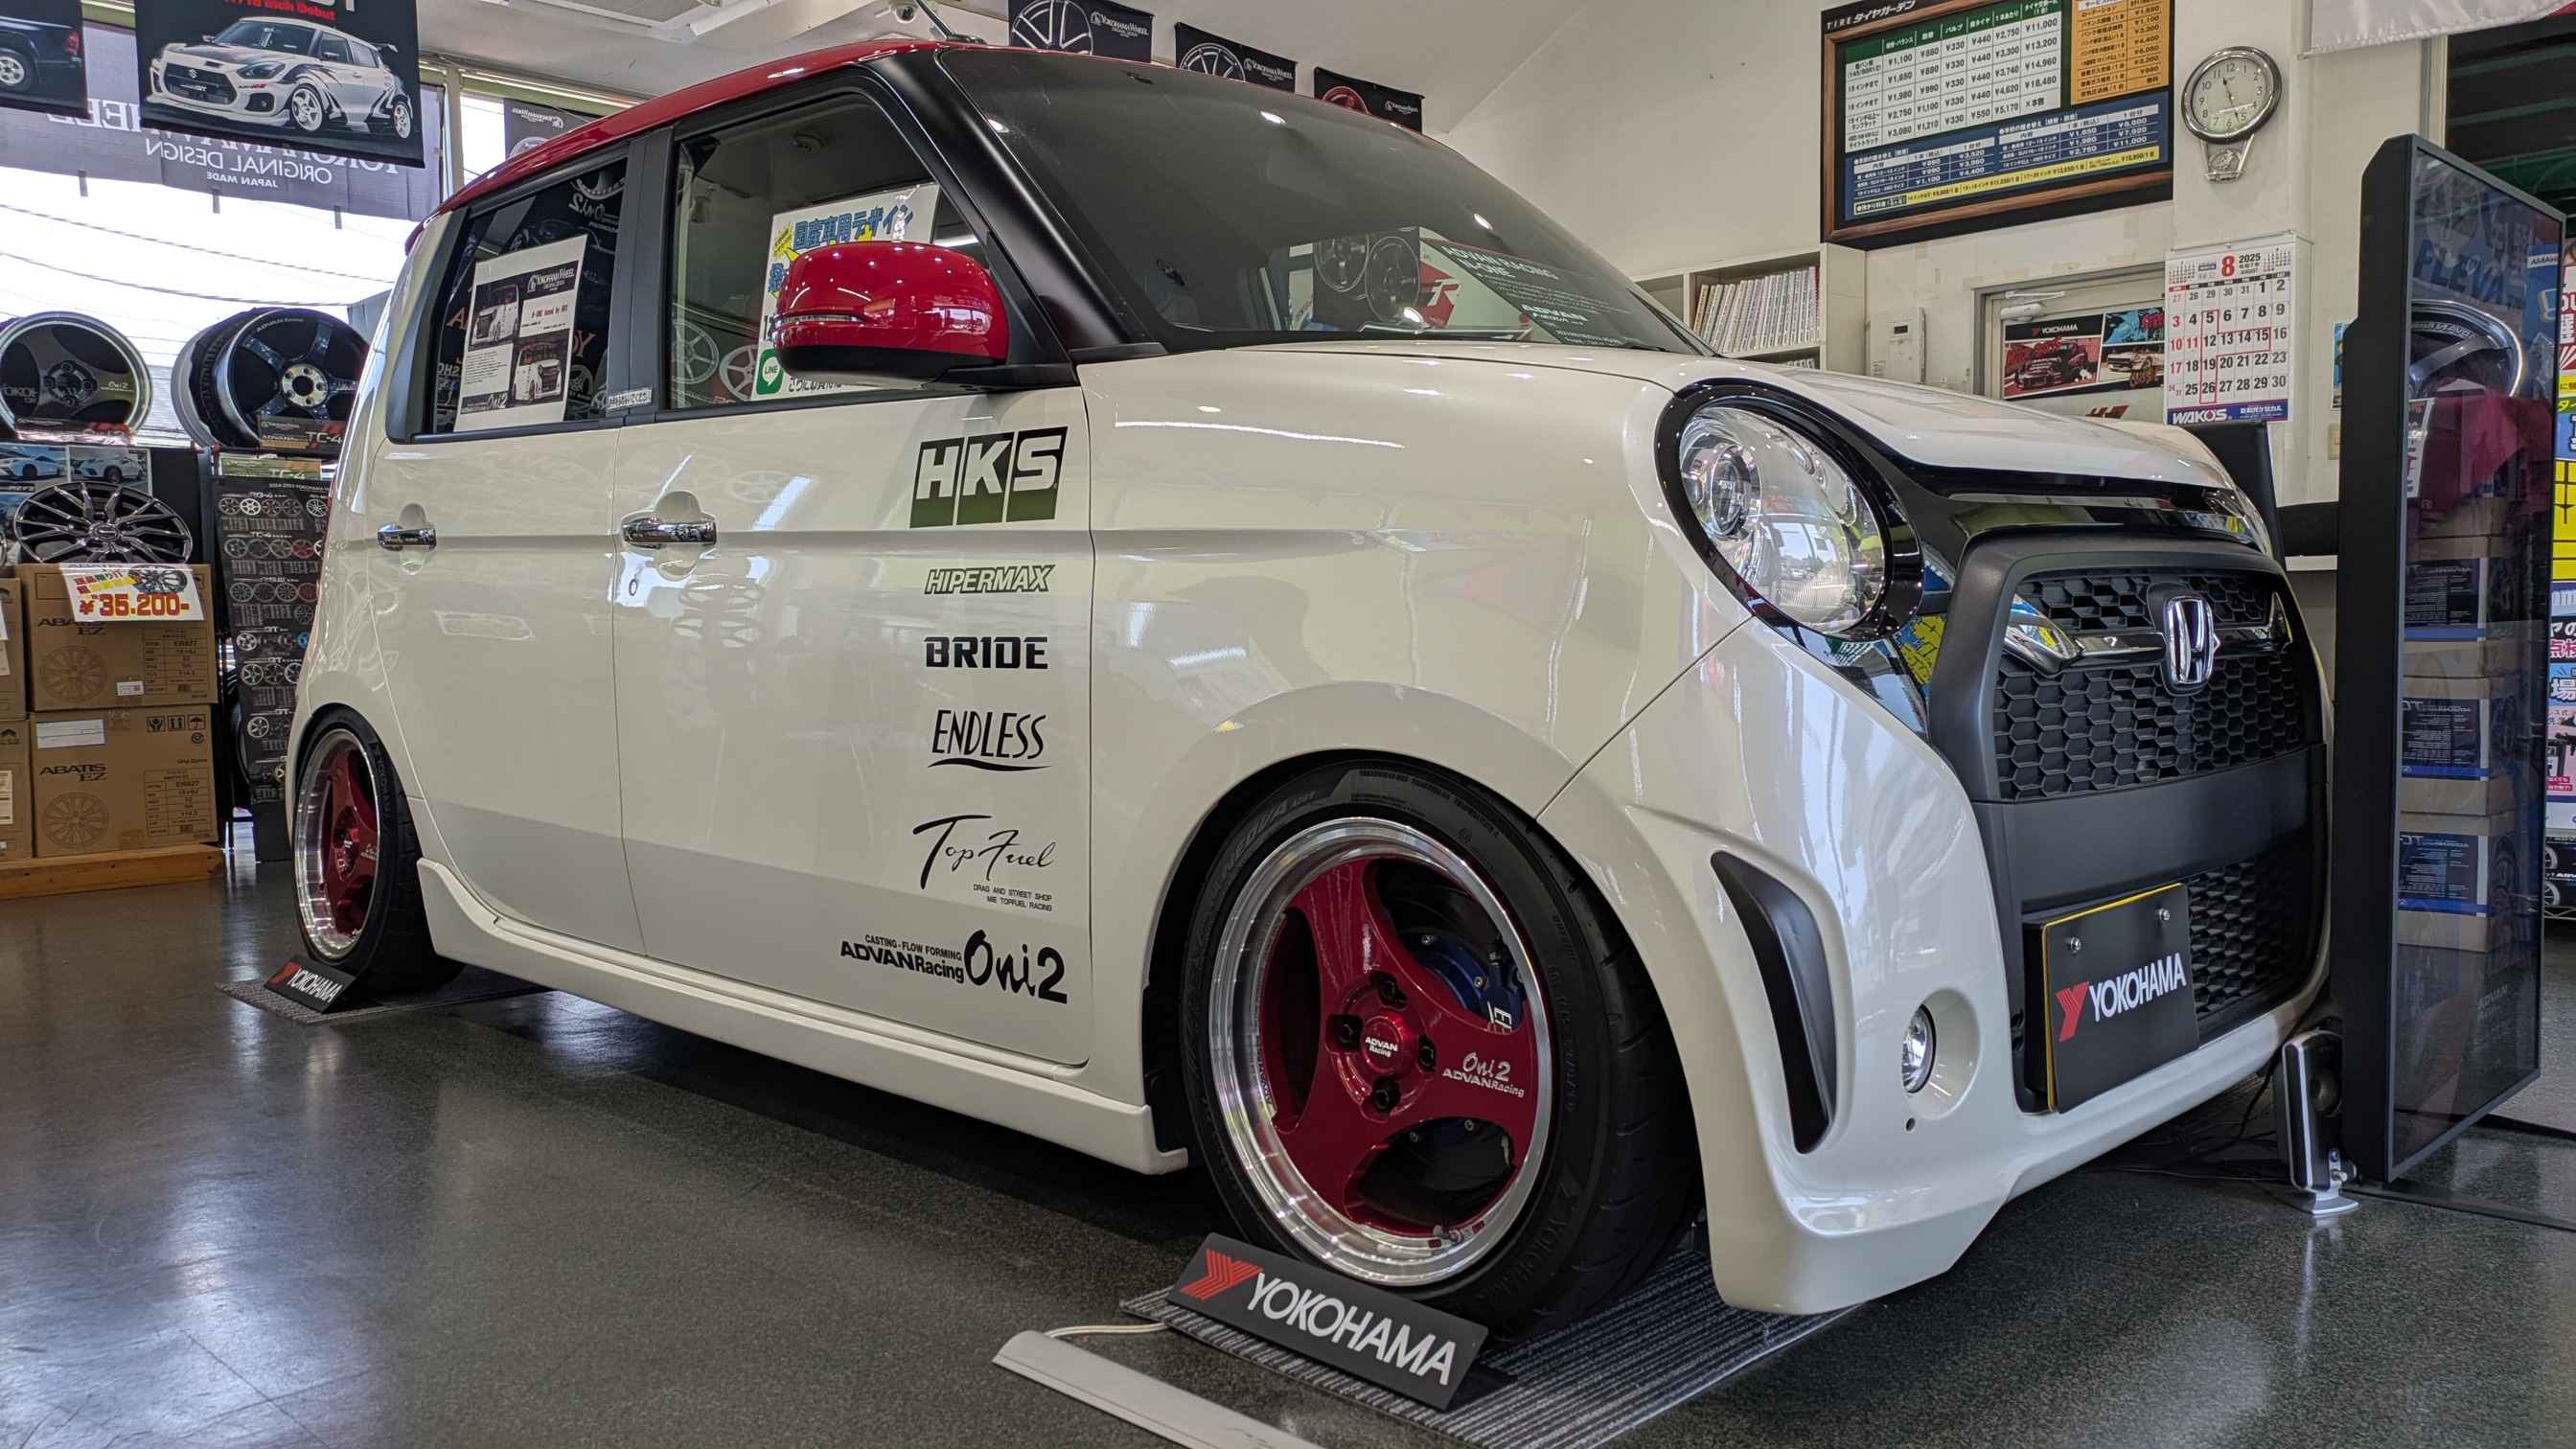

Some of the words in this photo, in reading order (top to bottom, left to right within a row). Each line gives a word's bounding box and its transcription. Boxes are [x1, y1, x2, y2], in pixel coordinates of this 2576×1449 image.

[1945, 40, 1965, 51] ¥330
[1972, 34, 1991, 45] ¥440
[1995, 28, 2019, 39] ¥2,750
[2025, 18, 2058, 33] ¥11,000
[1945, 59, 1965, 70] ¥330
[1971, 53, 1991, 63] ¥440
[1995, 46, 2019, 58] ¥3,300
[2025, 37, 2058, 51] ¥13,200
[1920, 84, 1939, 95] ¥990
[1945, 79, 1965, 89] ¥330
[1971, 72, 1990, 82] ¥440
[1995, 65, 2019, 78] ¥3,740
[2025, 57, 2057, 70] ¥14,960
[1888, 108, 1912, 121] ¥2,750
[1917, 103, 1939, 113] ¥1,100
[1944, 96, 1965, 107] ¥330
[1971, 90, 1990, 102] ¥440
[1994, 84, 2019, 96] ¥4,620
[2025, 76, 2057, 89] ¥18,480
[1917, 120, 1939, 131] ¥1,210
[1944, 114, 1965, 126] ¥330
[1970, 108, 1990, 120] ¥550
[1995, 103, 2019, 115] ¥5,170
[2113, 136, 2147, 148] ¥11,000
[2221, 255, 2235, 277] 8
[2239, 253, 2261, 264] 2025
[2189, 291, 2198, 300] 28
[2206, 289, 2216, 298] 29
[2223, 288, 2233, 296] 30
[2241, 286, 2249, 294] 31
[2259, 281, 2266, 293] 1
[2276, 279, 2286, 291] 2
[2173, 315, 2180, 328] 3
[2189, 313, 2197, 325] 4
[2206, 311, 2214, 324] 5
[2223, 310, 2232, 321] 6
[2241, 308, 2249, 319] 7
[2258, 305, 2266, 317] 8
[2275, 303, 2286, 315] 9
[2041, 323, 2079, 335] YOKOHAMA
[2171, 338, 2182, 351] 10
[2186, 336, 2197, 349] 11
[2204, 334, 2217, 347] 12
[2221, 333, 2233, 346] 13
[2239, 331, 2251, 344] 14
[2256, 329, 2268, 342] 15
[2273, 327, 2288, 339] 16
[765, 364, 779, 375] LINE
[2170, 362, 2182, 374] 17
[2186, 359, 2198, 372] 18
[2204, 358, 2216, 370] 19
[2220, 356, 2233, 369] 20
[2237, 355, 2249, 367] 21
[2254, 353, 2268, 365] 22
[2272, 352, 2287, 364] 23
[2185, 383, 2198, 396] 25
[2202, 382, 2216, 394] 26
[2219, 380, 2232, 392] 27
[2236, 379, 2250, 391] 28
[2254, 377, 2268, 389] 29
[2271, 376, 2287, 388] 30
[306, 431, 343, 444] TC-4
[268, 468, 307, 480] TC-4
[914, 434, 1064, 501] HKS
[924, 564, 1056, 594] HIPERMAX
[77, 627, 106, 636] EZ
[924, 636, 1048, 669] BRIDE
[932, 708, 1046, 760] ENDLESS
[39, 763, 107, 775] ABATIS
[78, 773, 107, 782] EZ
[912, 815, 993, 890] Top
[978, 829, 1056, 882] Fuel
[973, 883, 991, 894] DRAG
[993, 886, 1006, 896] AND
[1008, 888, 1032, 899] STREET
[1035, 892, 1052, 902] SHOP
[1000, 897, 1026, 908] TOPFUEL
[1029, 901, 1052, 911] RACING
[925, 945, 962, 961] FORMING
[287, 968, 345, 1004] YOKOHAMA
[2089, 953, 2187, 1023] YOKOHAMA
[1365, 1036, 1398, 1052] ADVAN
[1369, 1045, 1392, 1058] Racing
[1248, 1273, 1457, 1386] YOKOHAMA
